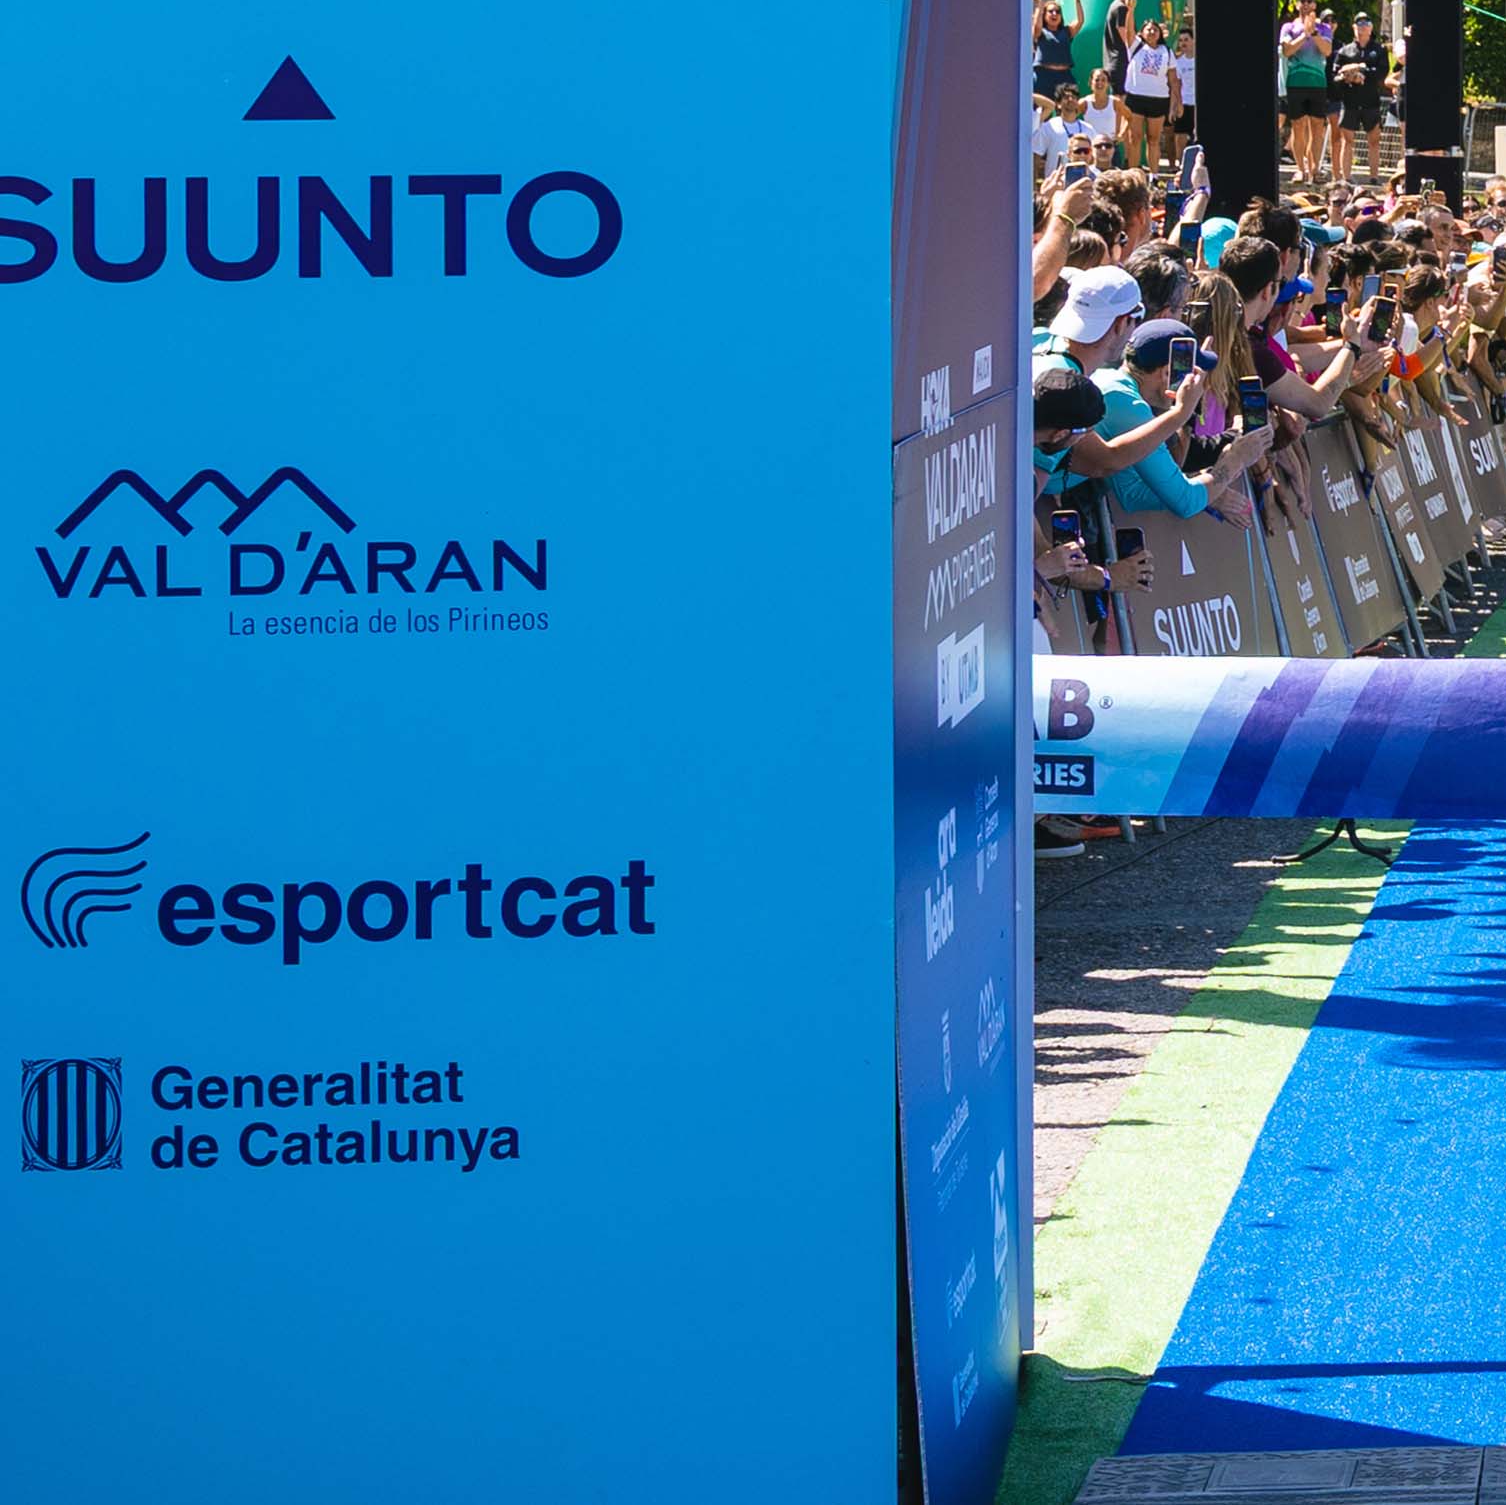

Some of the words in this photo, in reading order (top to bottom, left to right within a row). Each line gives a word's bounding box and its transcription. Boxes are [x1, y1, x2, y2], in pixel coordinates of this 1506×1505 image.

[0, 170, 623, 284] SUUNTO
[35, 543, 202, 598] VAL
[229, 530, 548, 596] D'ARAN
[228, 610, 256, 637] La
[265, 607, 359, 636] esencia
[368, 607, 398, 635] de
[407, 606, 440, 634] los
[448, 605, 549, 633] Pirineos
[1153, 594, 1242, 656] SUUNTO
[157, 859, 656, 965] esportcat
[150, 1061, 464, 1110] Generalitat
[150, 1125, 219, 1169] de
[238, 1120, 520, 1173] Catalunya
